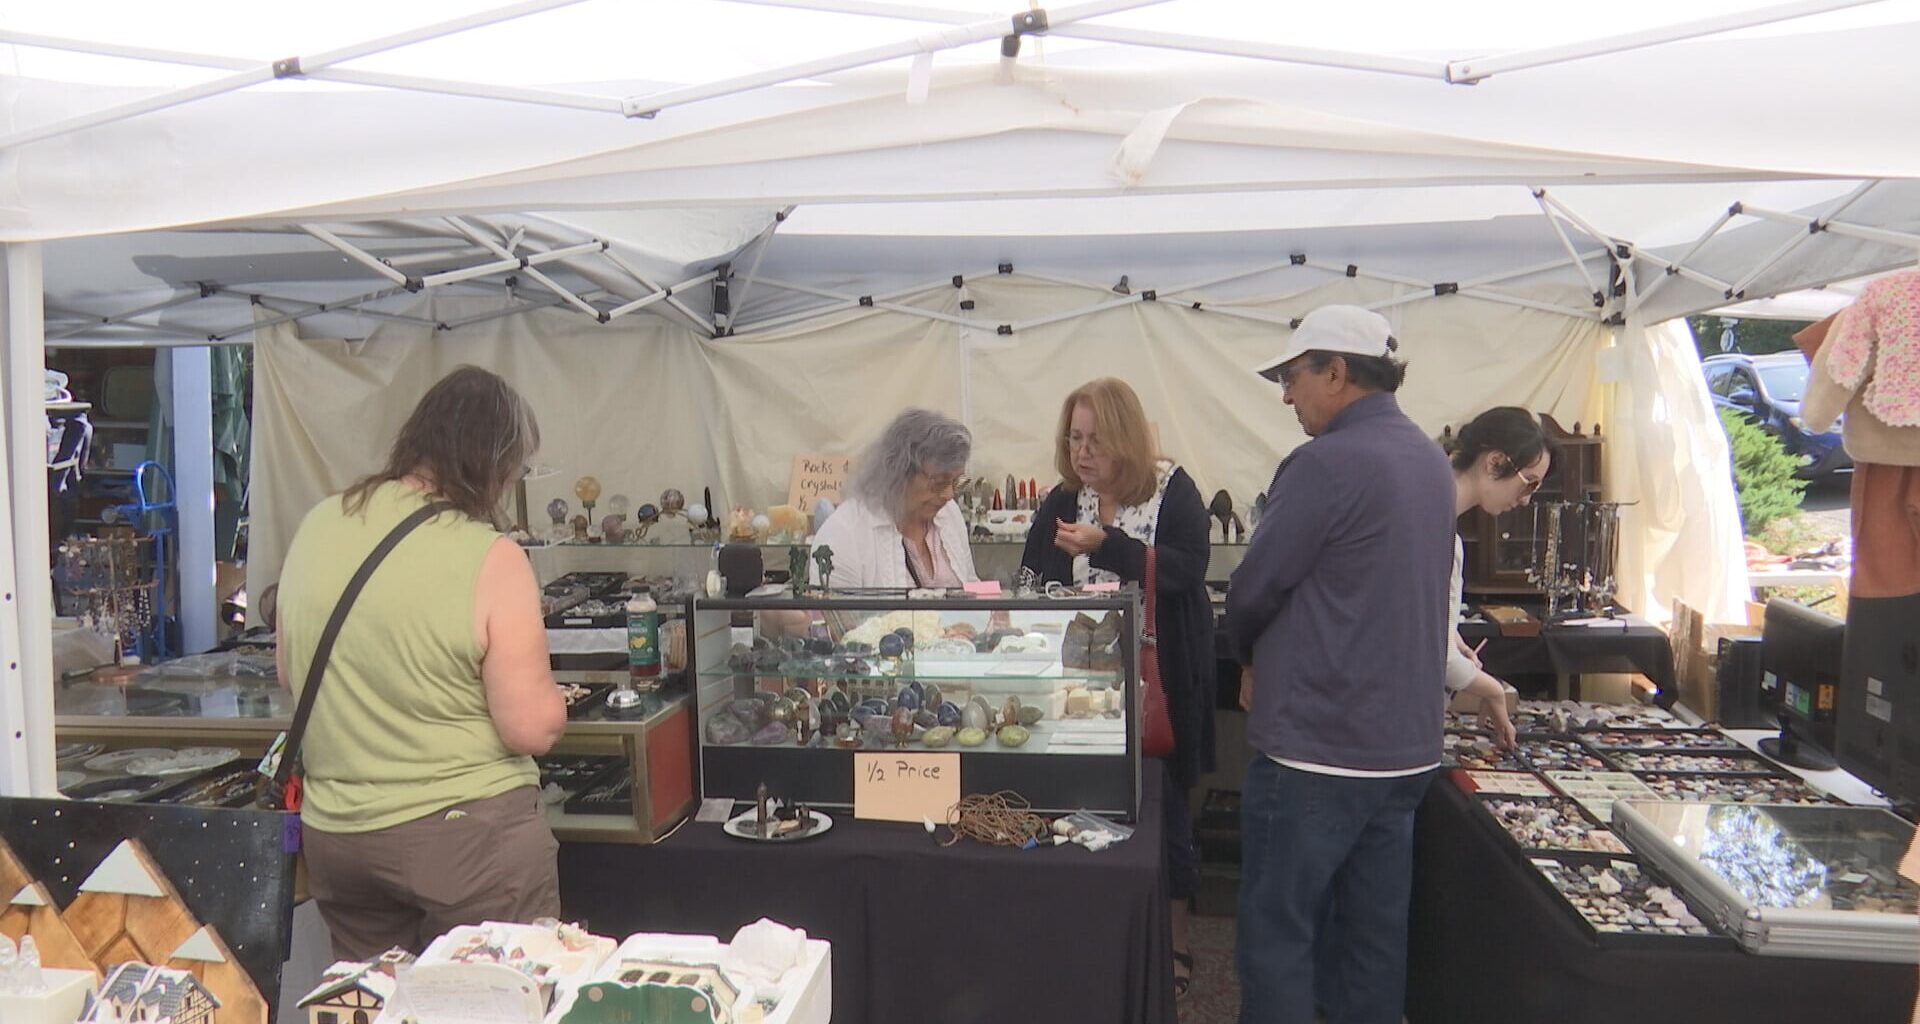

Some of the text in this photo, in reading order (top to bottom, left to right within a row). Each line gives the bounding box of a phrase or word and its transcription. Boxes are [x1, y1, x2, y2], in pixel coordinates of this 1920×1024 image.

[802, 459, 833, 475] Rocks
[867, 760, 941, 783] 1/2 Price
